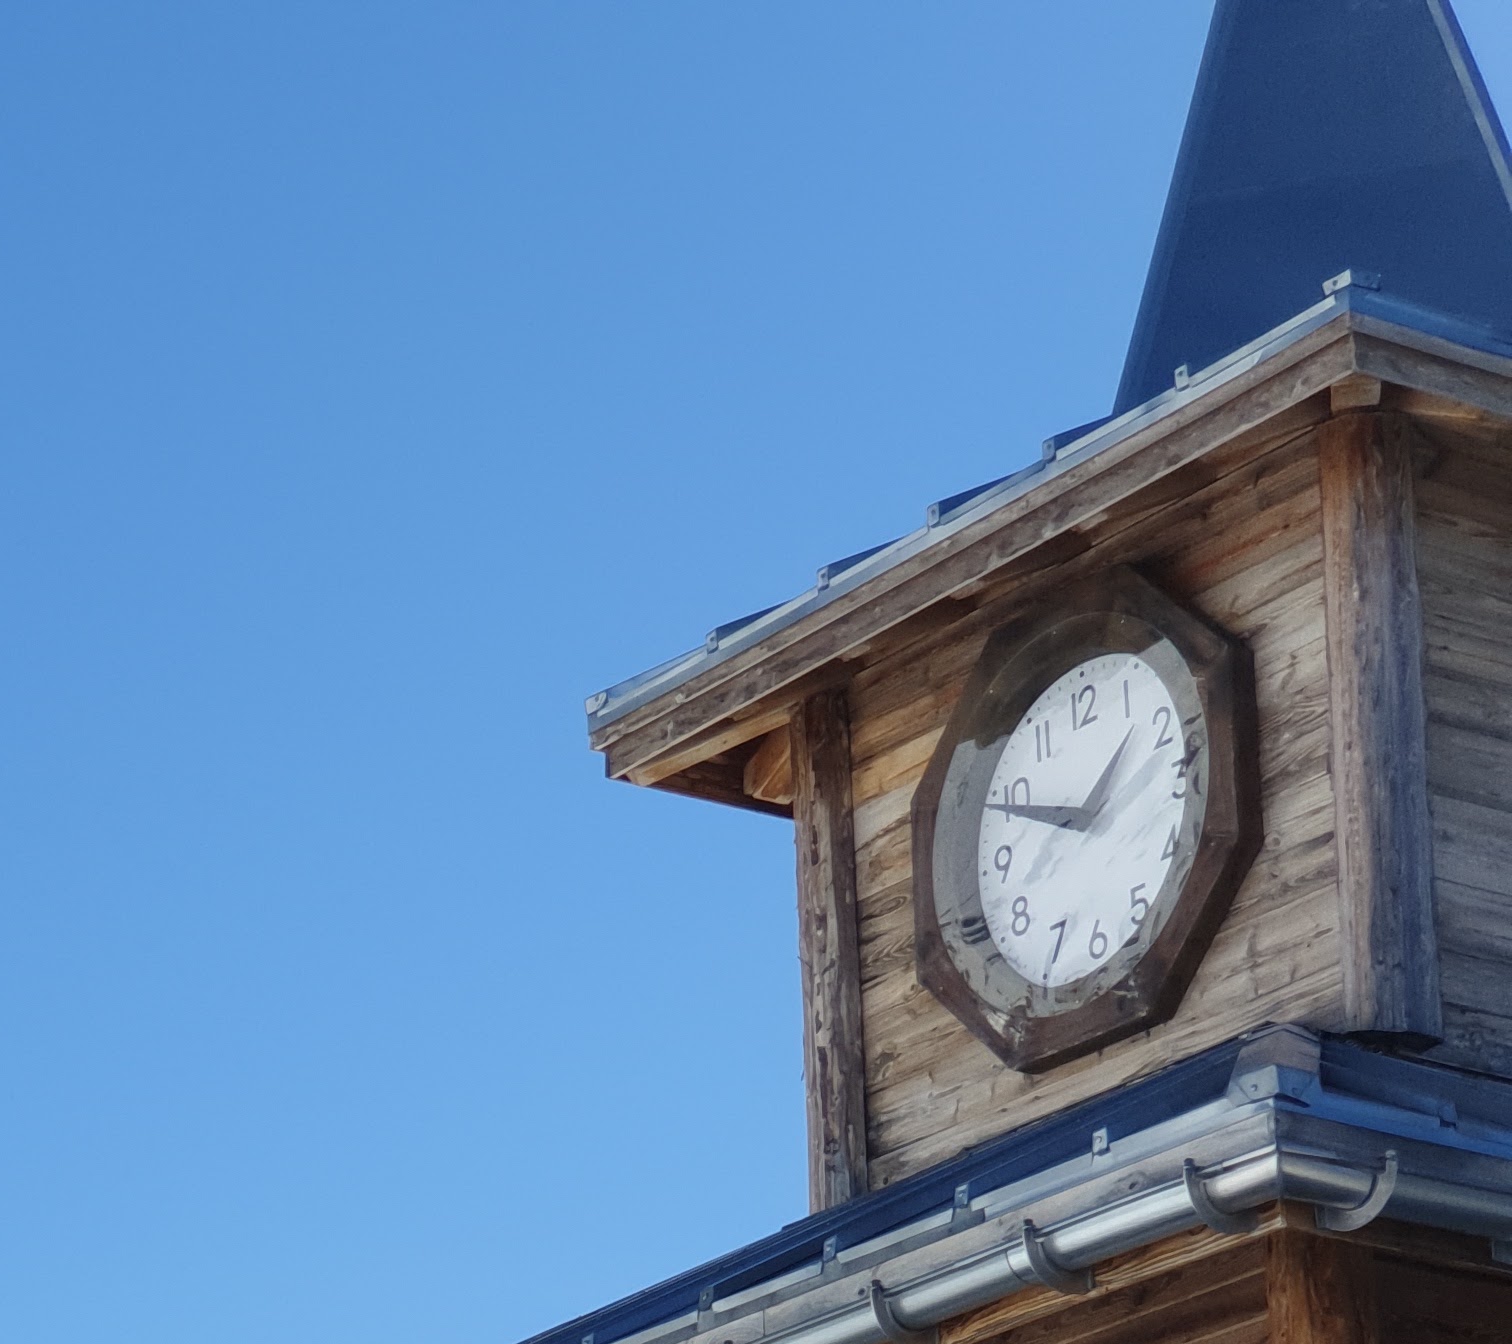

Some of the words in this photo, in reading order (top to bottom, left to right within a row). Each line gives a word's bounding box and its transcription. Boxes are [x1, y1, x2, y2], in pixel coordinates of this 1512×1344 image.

[1071, 684, 1099, 731] 12
[1123, 680, 1131, 719] 1
[1035, 719, 1052, 763] 11
[1152, 706, 1173, 751] 2
[1004, 776, 1031, 823] 10
[1171, 761, 1187, 801] 3
[993, 844, 1013, 885] 9
[1161, 825, 1180, 862] 4
[1011, 895, 1031, 936] 8
[1129, 882, 1150, 930] 5
[1049, 918, 1068, 964] 7
[1088, 919, 1109, 960] 6
